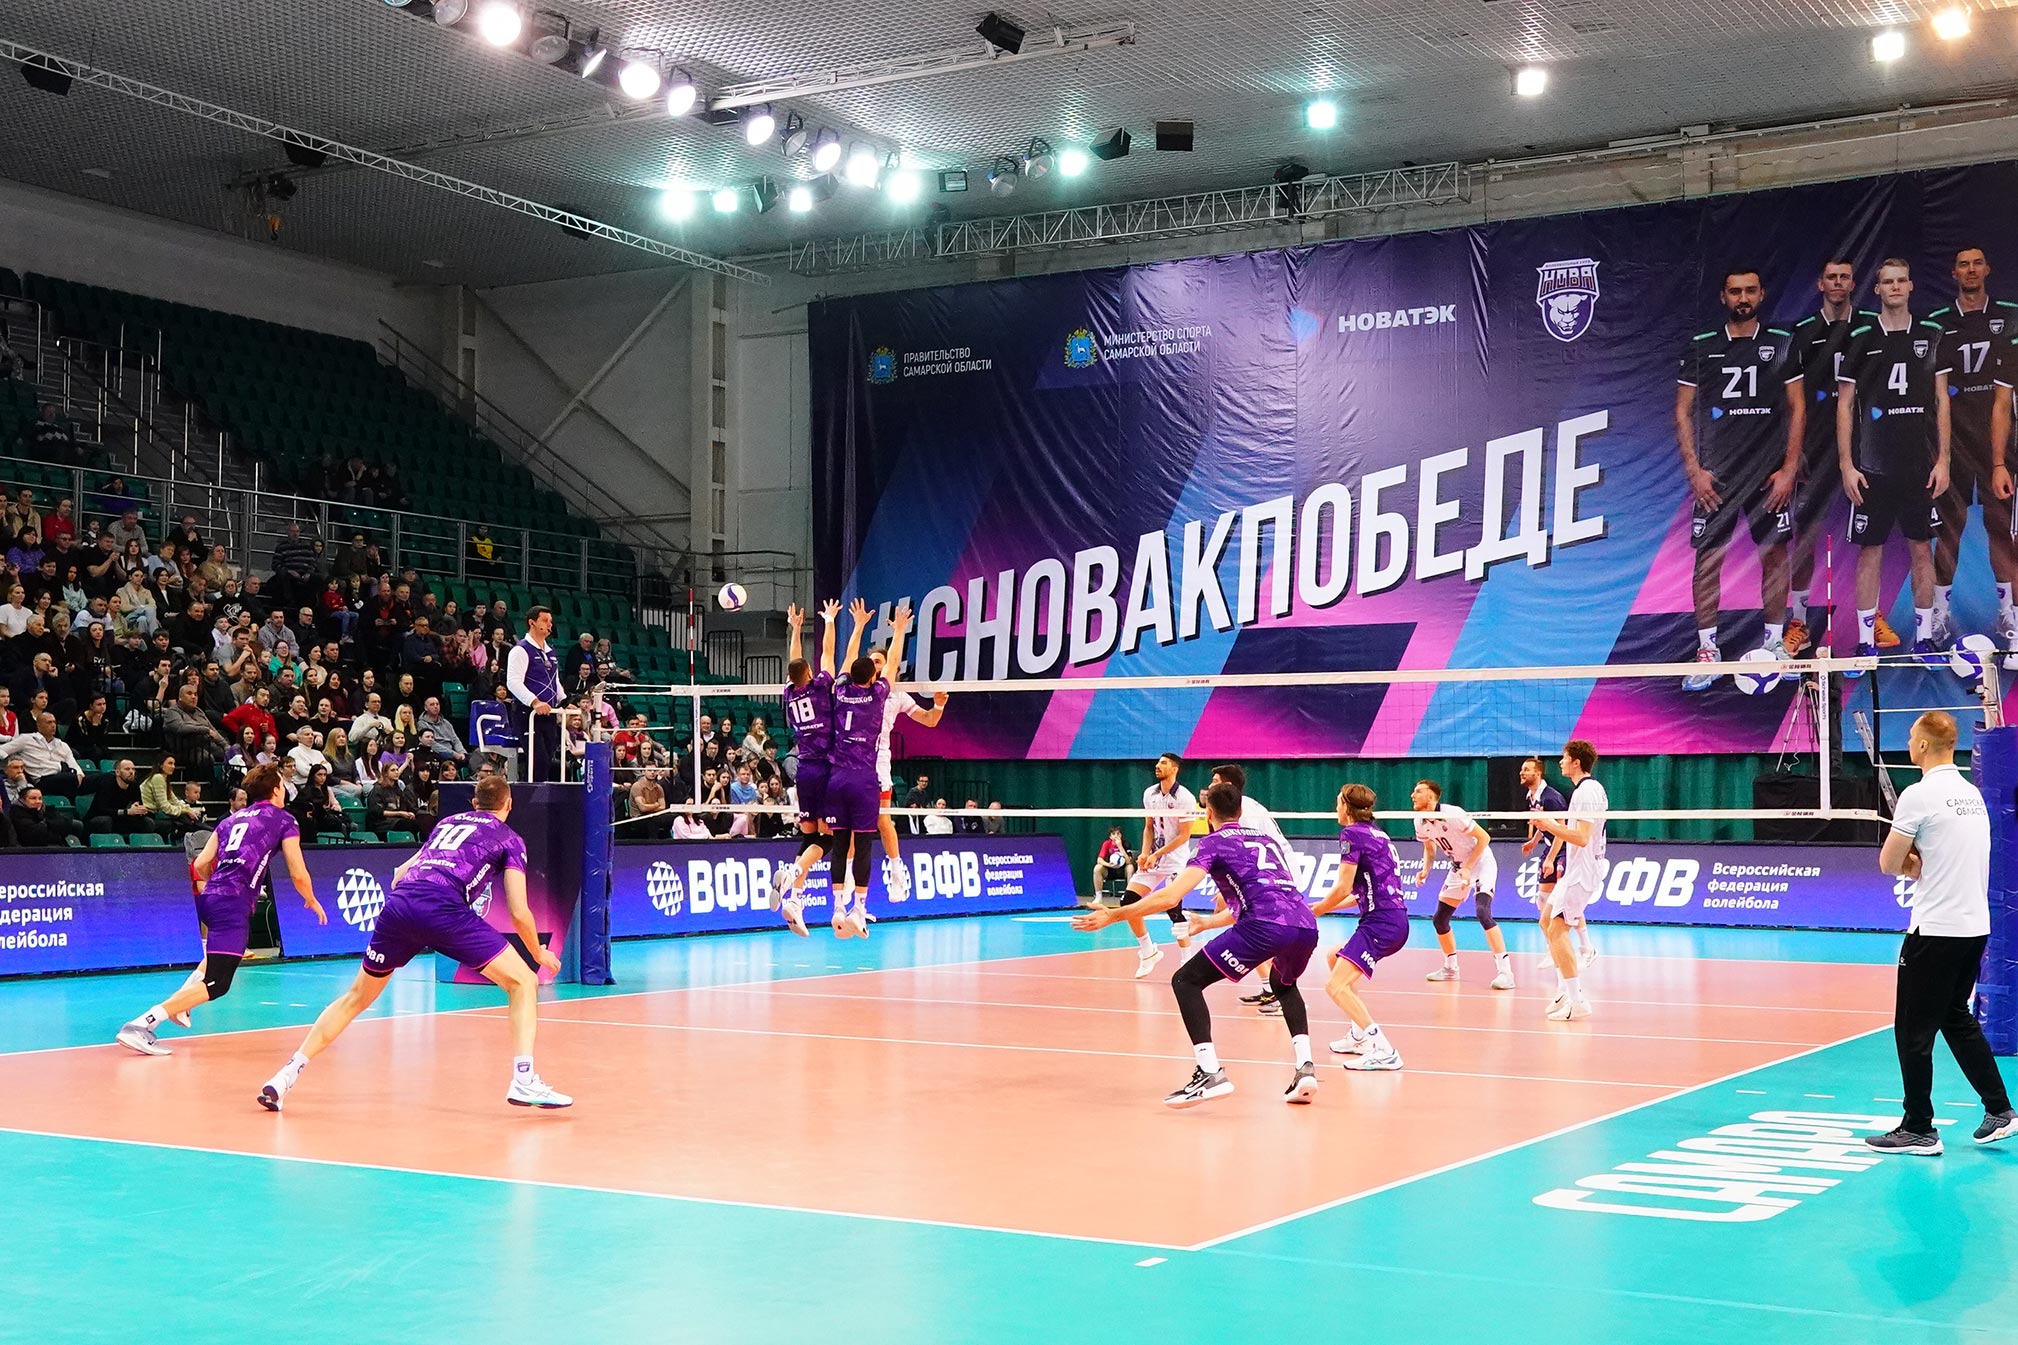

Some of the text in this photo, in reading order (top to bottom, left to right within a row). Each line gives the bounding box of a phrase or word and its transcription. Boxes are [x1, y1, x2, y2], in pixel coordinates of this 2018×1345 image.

[1541, 266, 1595, 296] НОВА
[1338, 303, 1457, 333] НОВАТЭК
[1103, 325, 1212, 346] МИНИСТЕРСТВО СПОРТА
[903, 347, 971, 364] ПРАВИТЕЛЬСТВО
[1103, 340, 1200, 361] САМАРСКОЙ ОБЛАСТИ
[1957, 340, 1991, 374] 17
[903, 358, 992, 377] САМАРСКОЙ ОБЛАСТИ
[1887, 362, 1909, 396] 4
[1722, 365, 1757, 399] 21
[1729, 407, 1771, 416] НОВАТЭК
[1887, 406, 1925, 416] НОВАТЭК
[1776, 511, 1790, 528] 21
[870, 409, 1608, 699] #СНОВАКПОБЕДЕ
[789, 697, 816, 724] 18
[844, 710, 853, 731] 1
[224, 822, 249, 852] 8
[428, 823, 478, 851] 10
[1435, 836, 1453, 851] 10
[913, 850, 981, 900] ВФВ
[1712, 862, 1820, 878] Всероссийская
[688, 857, 772, 914] ВФВ
[1707, 879, 1788, 893] федерация
[1703, 896, 1779, 910] волейбола
[1531, 1110, 1959, 1223] САМАРА
